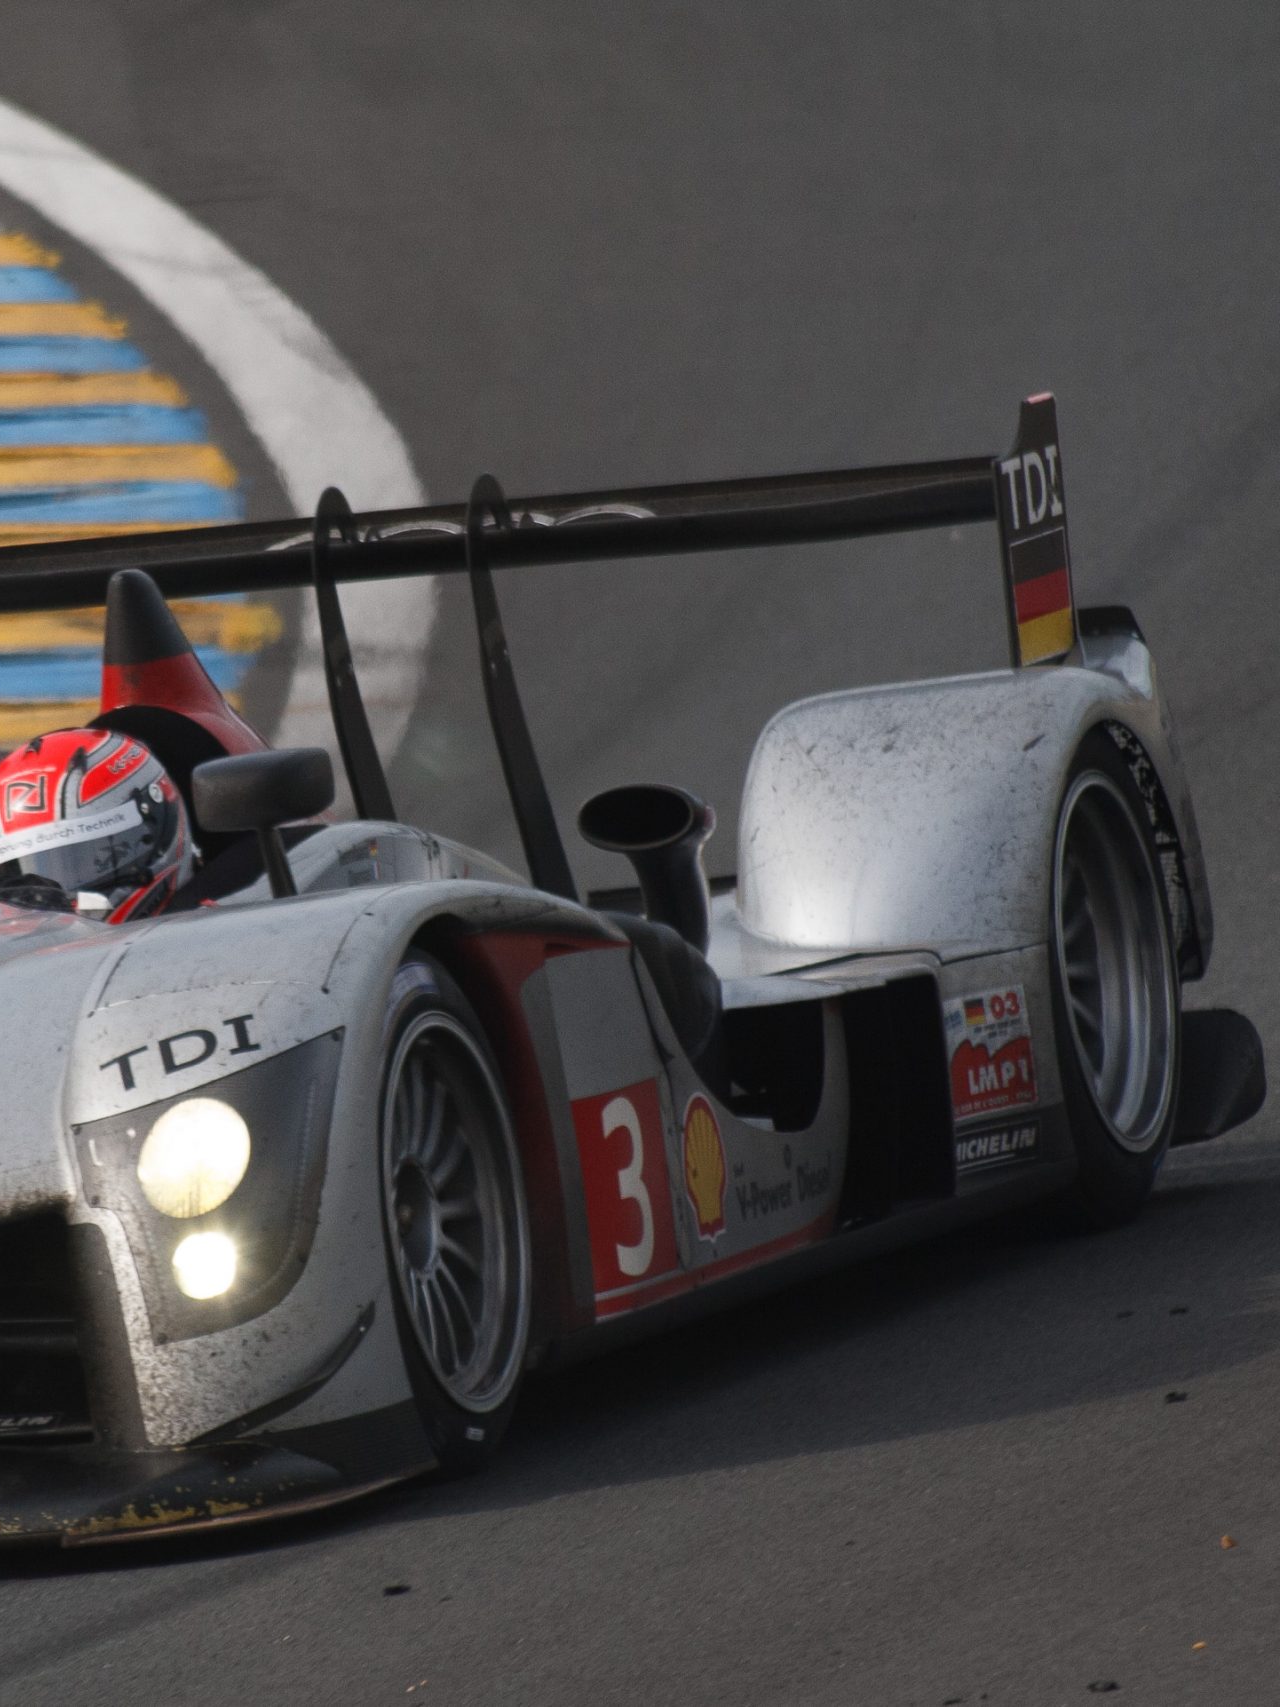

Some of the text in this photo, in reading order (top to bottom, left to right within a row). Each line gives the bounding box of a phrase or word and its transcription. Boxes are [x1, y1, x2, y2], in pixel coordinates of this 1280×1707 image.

[1001, 444, 1063, 530] TDI
[990, 992, 1019, 1020] 03
[99, 1014, 261, 1091] TDI
[602, 1096, 655, 1277] 3
